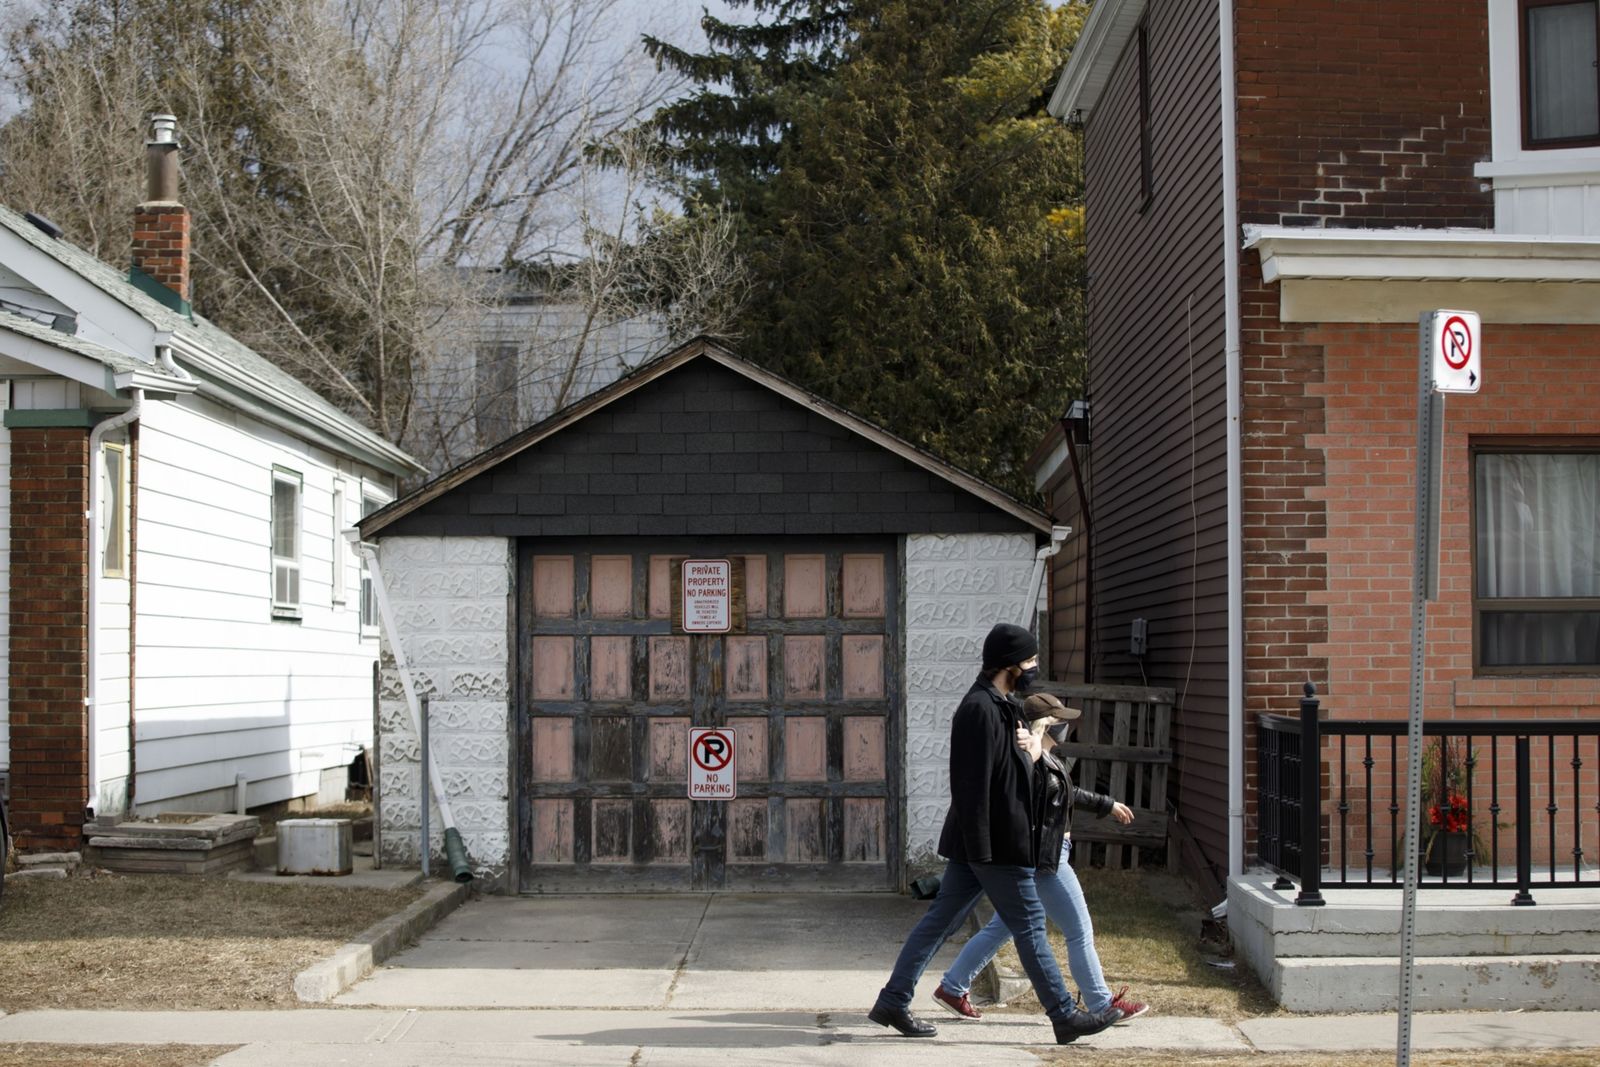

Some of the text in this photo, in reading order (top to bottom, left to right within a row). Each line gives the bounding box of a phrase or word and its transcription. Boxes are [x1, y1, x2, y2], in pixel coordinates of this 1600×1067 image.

[691, 566, 721, 575] PRIVATE
[688, 577, 725, 586] PROPERTY
[687, 589, 726, 597] NO PARKING
[706, 773, 719, 783] NO
[694, 784, 731, 793] PARKING
